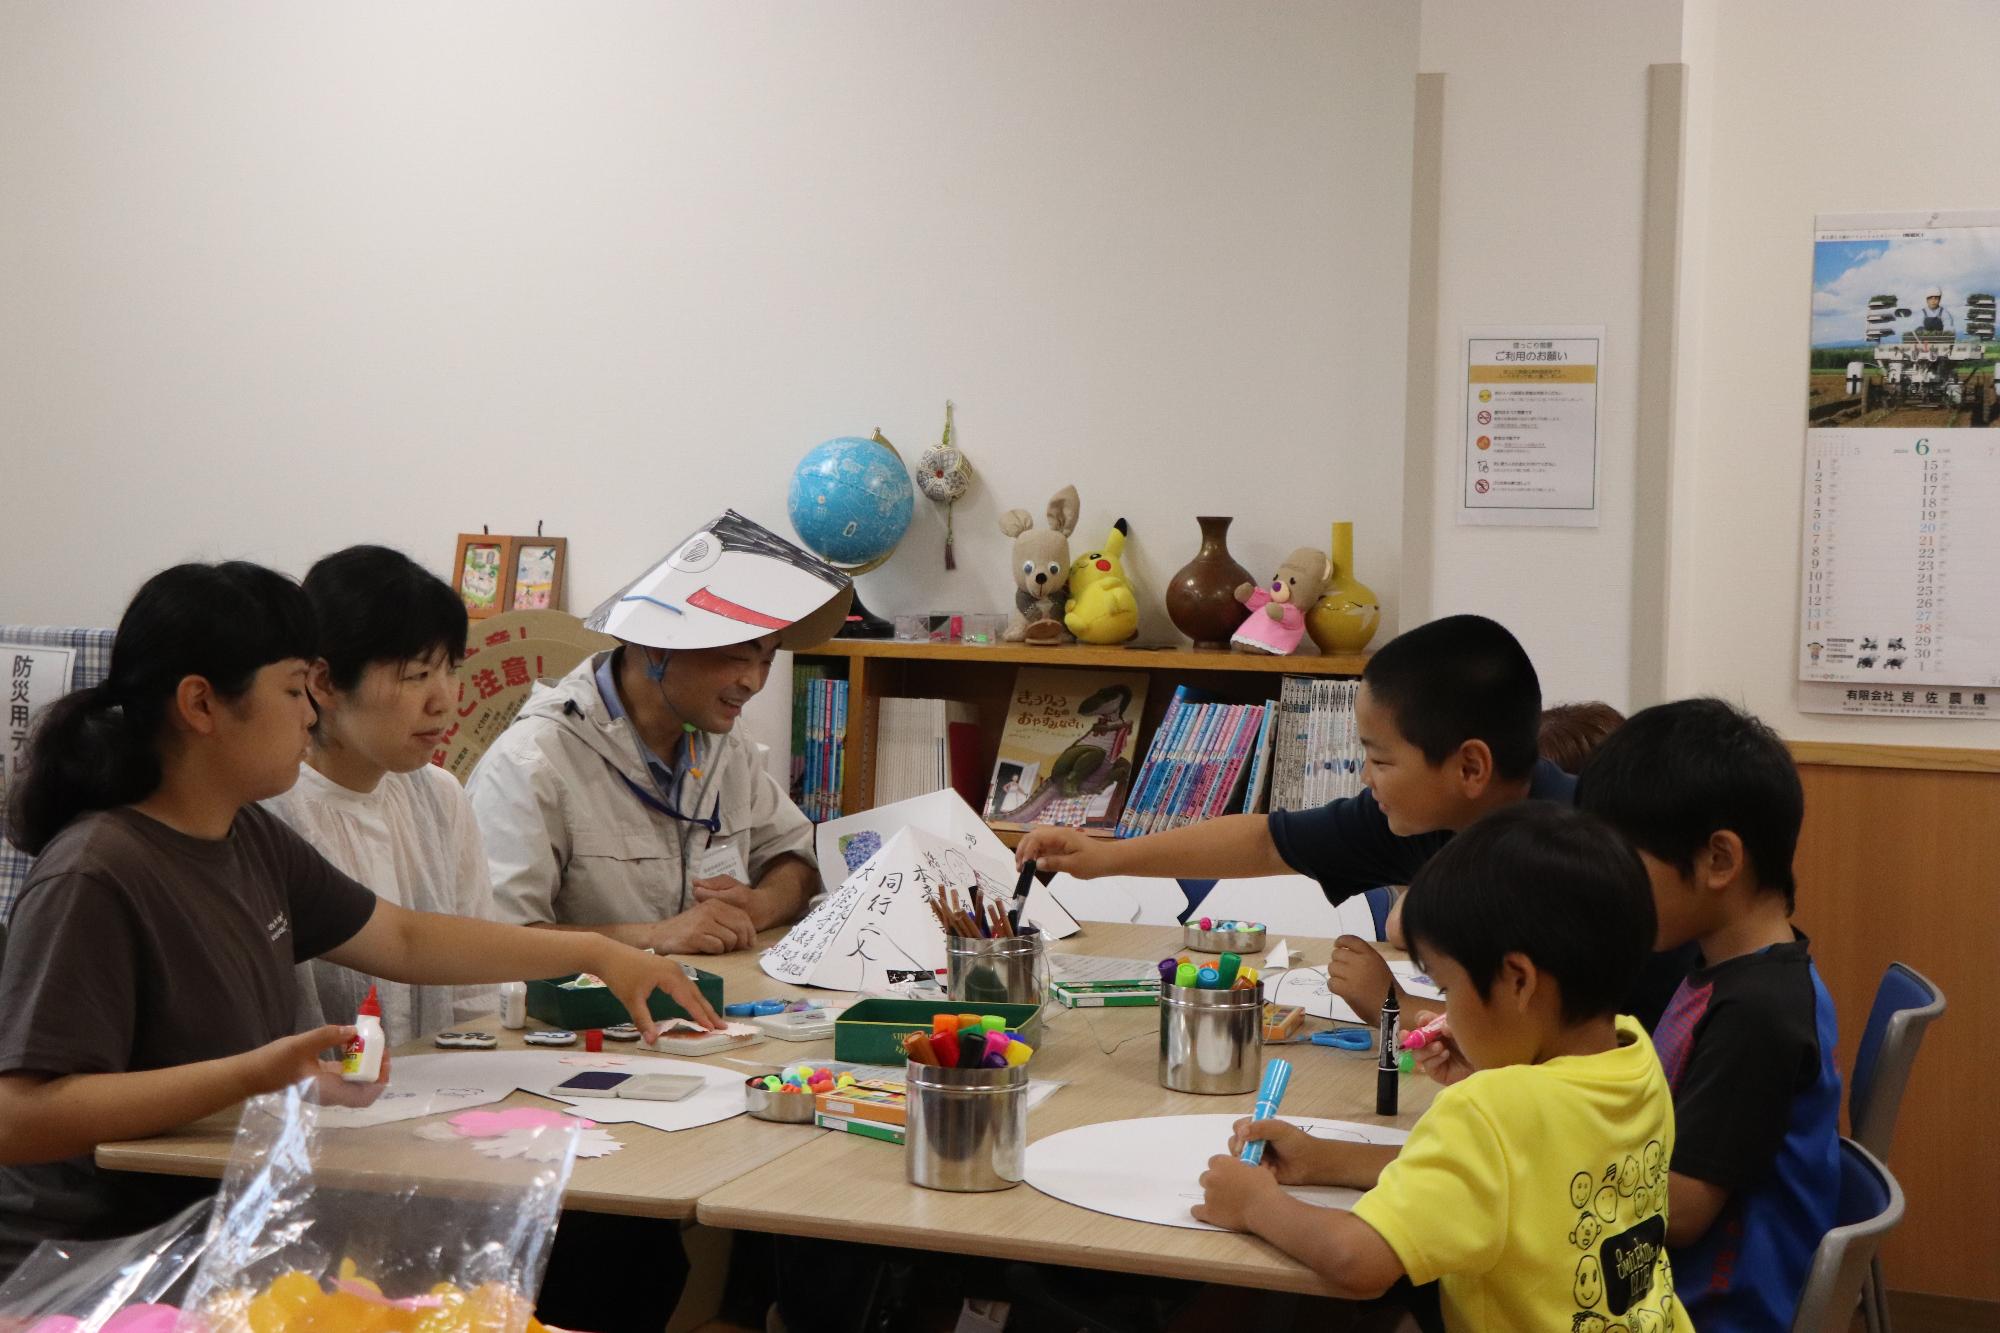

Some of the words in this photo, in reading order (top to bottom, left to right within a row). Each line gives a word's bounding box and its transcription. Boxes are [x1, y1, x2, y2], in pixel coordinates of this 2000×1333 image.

[1495, 351, 1568, 362] ご利用のお願い
[1915, 438, 1930, 456] 6
[1924, 460, 1939, 471] 15
[1923, 472, 1938, 483] 16
[1923, 485, 1937, 496] 17
[1922, 497, 1937, 508] 18
[1921, 510, 1937, 521] 19
[1919, 522, 1936, 533] 20
[1919, 535, 1934, 546] 21
[1918, 548, 1935, 559] 22
[1917, 560, 1934, 571] 23
[1809, 571, 1823, 581] 10
[1917, 573, 1933, 584] 24
[1808, 583, 1821, 594] 11
[1916, 585, 1933, 596] 25
[1808, 596, 1822, 606] 12
[1916, 598, 1933, 609] 26
[1916, 610, 1932, 621] 27
[1807, 620, 1820, 631] 14
[1915, 623, 1932, 634] 28
[1914, 635, 1931, 647] 29
[1914, 648, 1931, 659] 30
[1846, 689, 1895, 702] 有限会社
[1017, 712, 1084, 729] おやすみなさい
